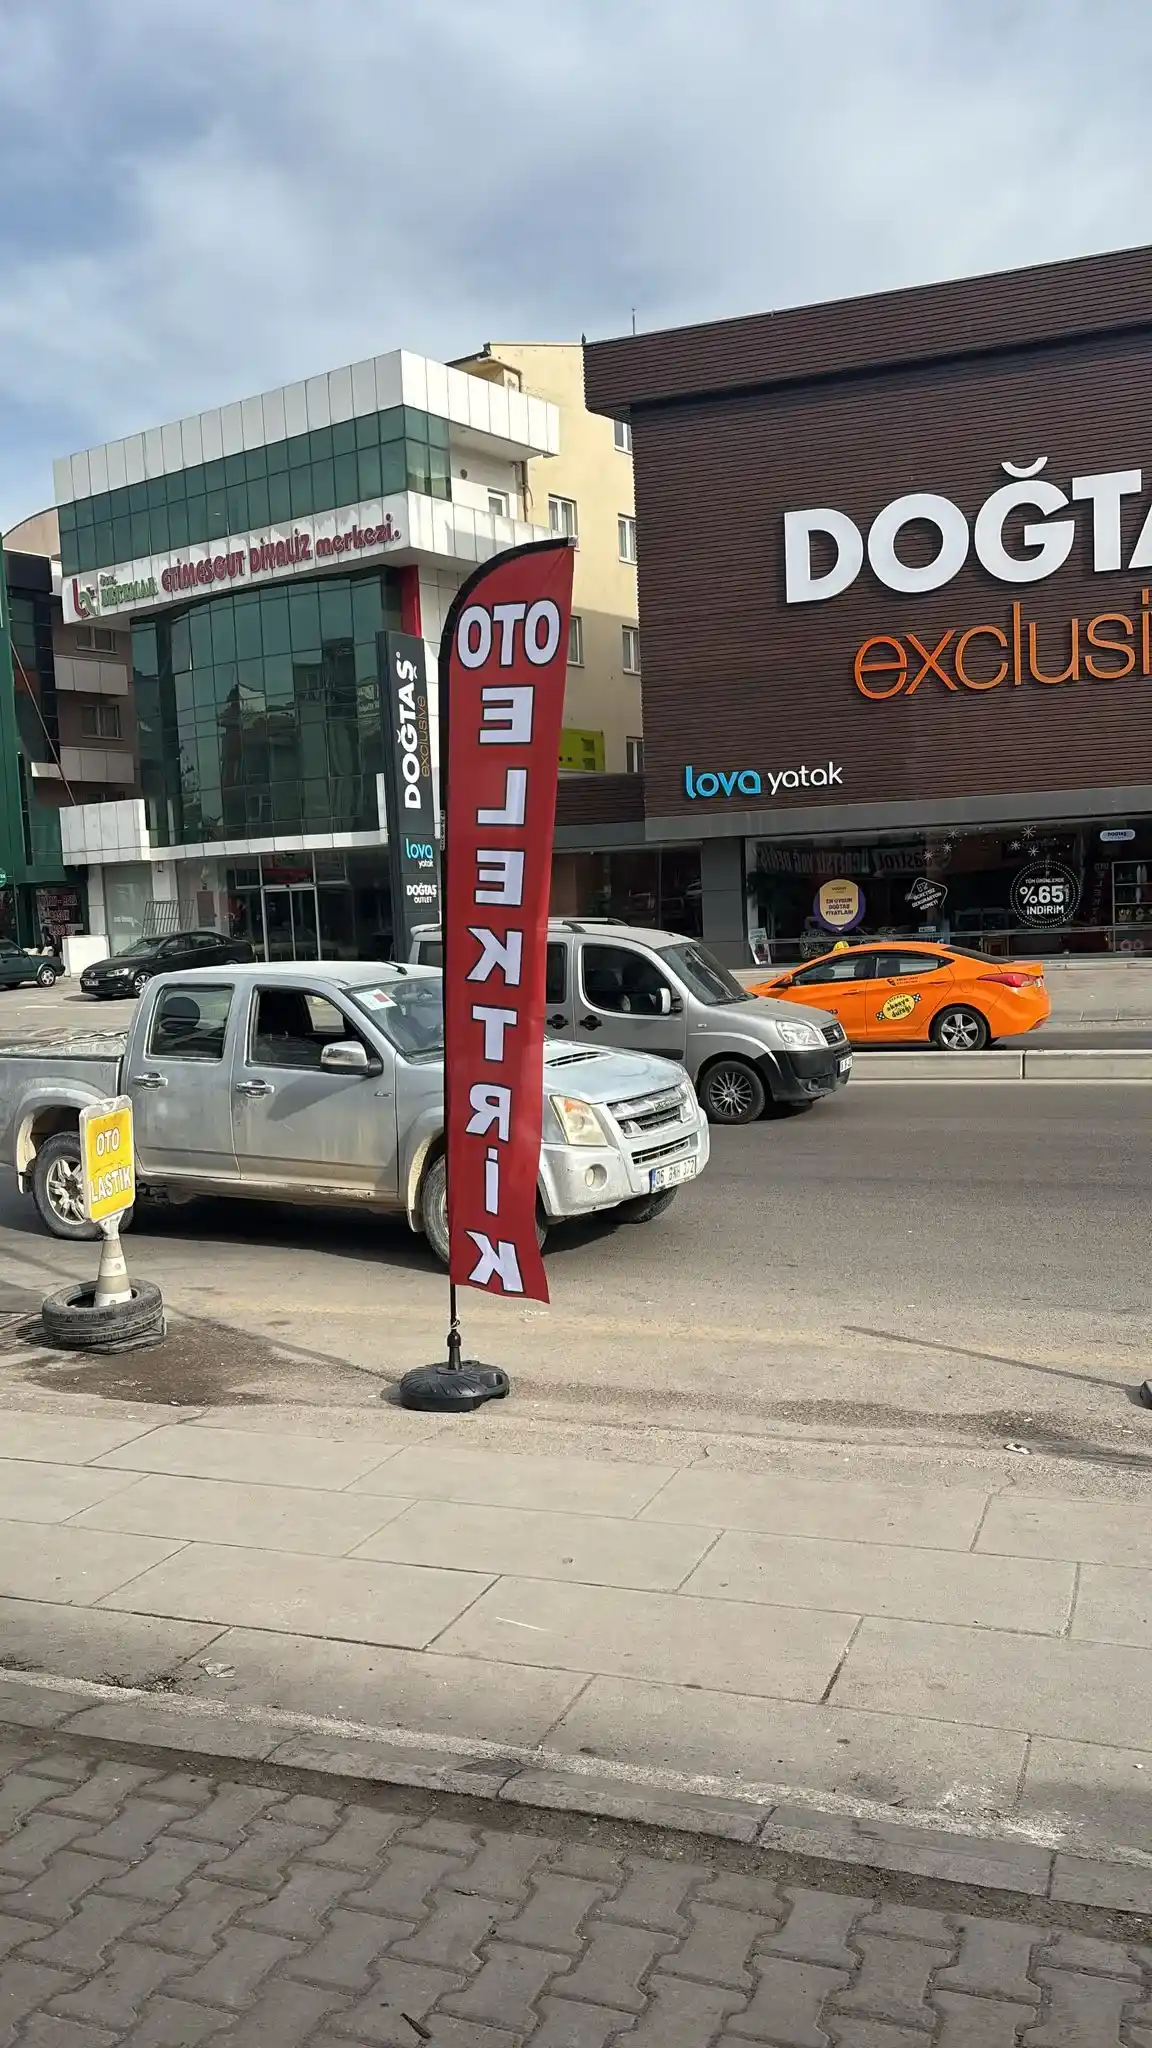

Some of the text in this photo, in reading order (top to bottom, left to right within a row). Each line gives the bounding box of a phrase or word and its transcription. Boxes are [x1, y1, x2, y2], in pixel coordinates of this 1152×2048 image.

[784, 456, 1152, 604] DOĞT
[249, 528, 313, 574] DİYALİZ
[395, 657, 421, 809] DOĞTAŞ
[416, 695, 430, 777] exclusive
[685, 761, 843, 799] lova yatak
[405, 838, 433, 859] lova
[406, 883, 437, 897] DOĞTAŞ
[1019, 885, 1064, 904] %65
[1026, 905, 1064, 915] İNDİRİM
[95, 1127, 120, 1156] OTO
[89, 1162, 133, 1203] LASTİK
